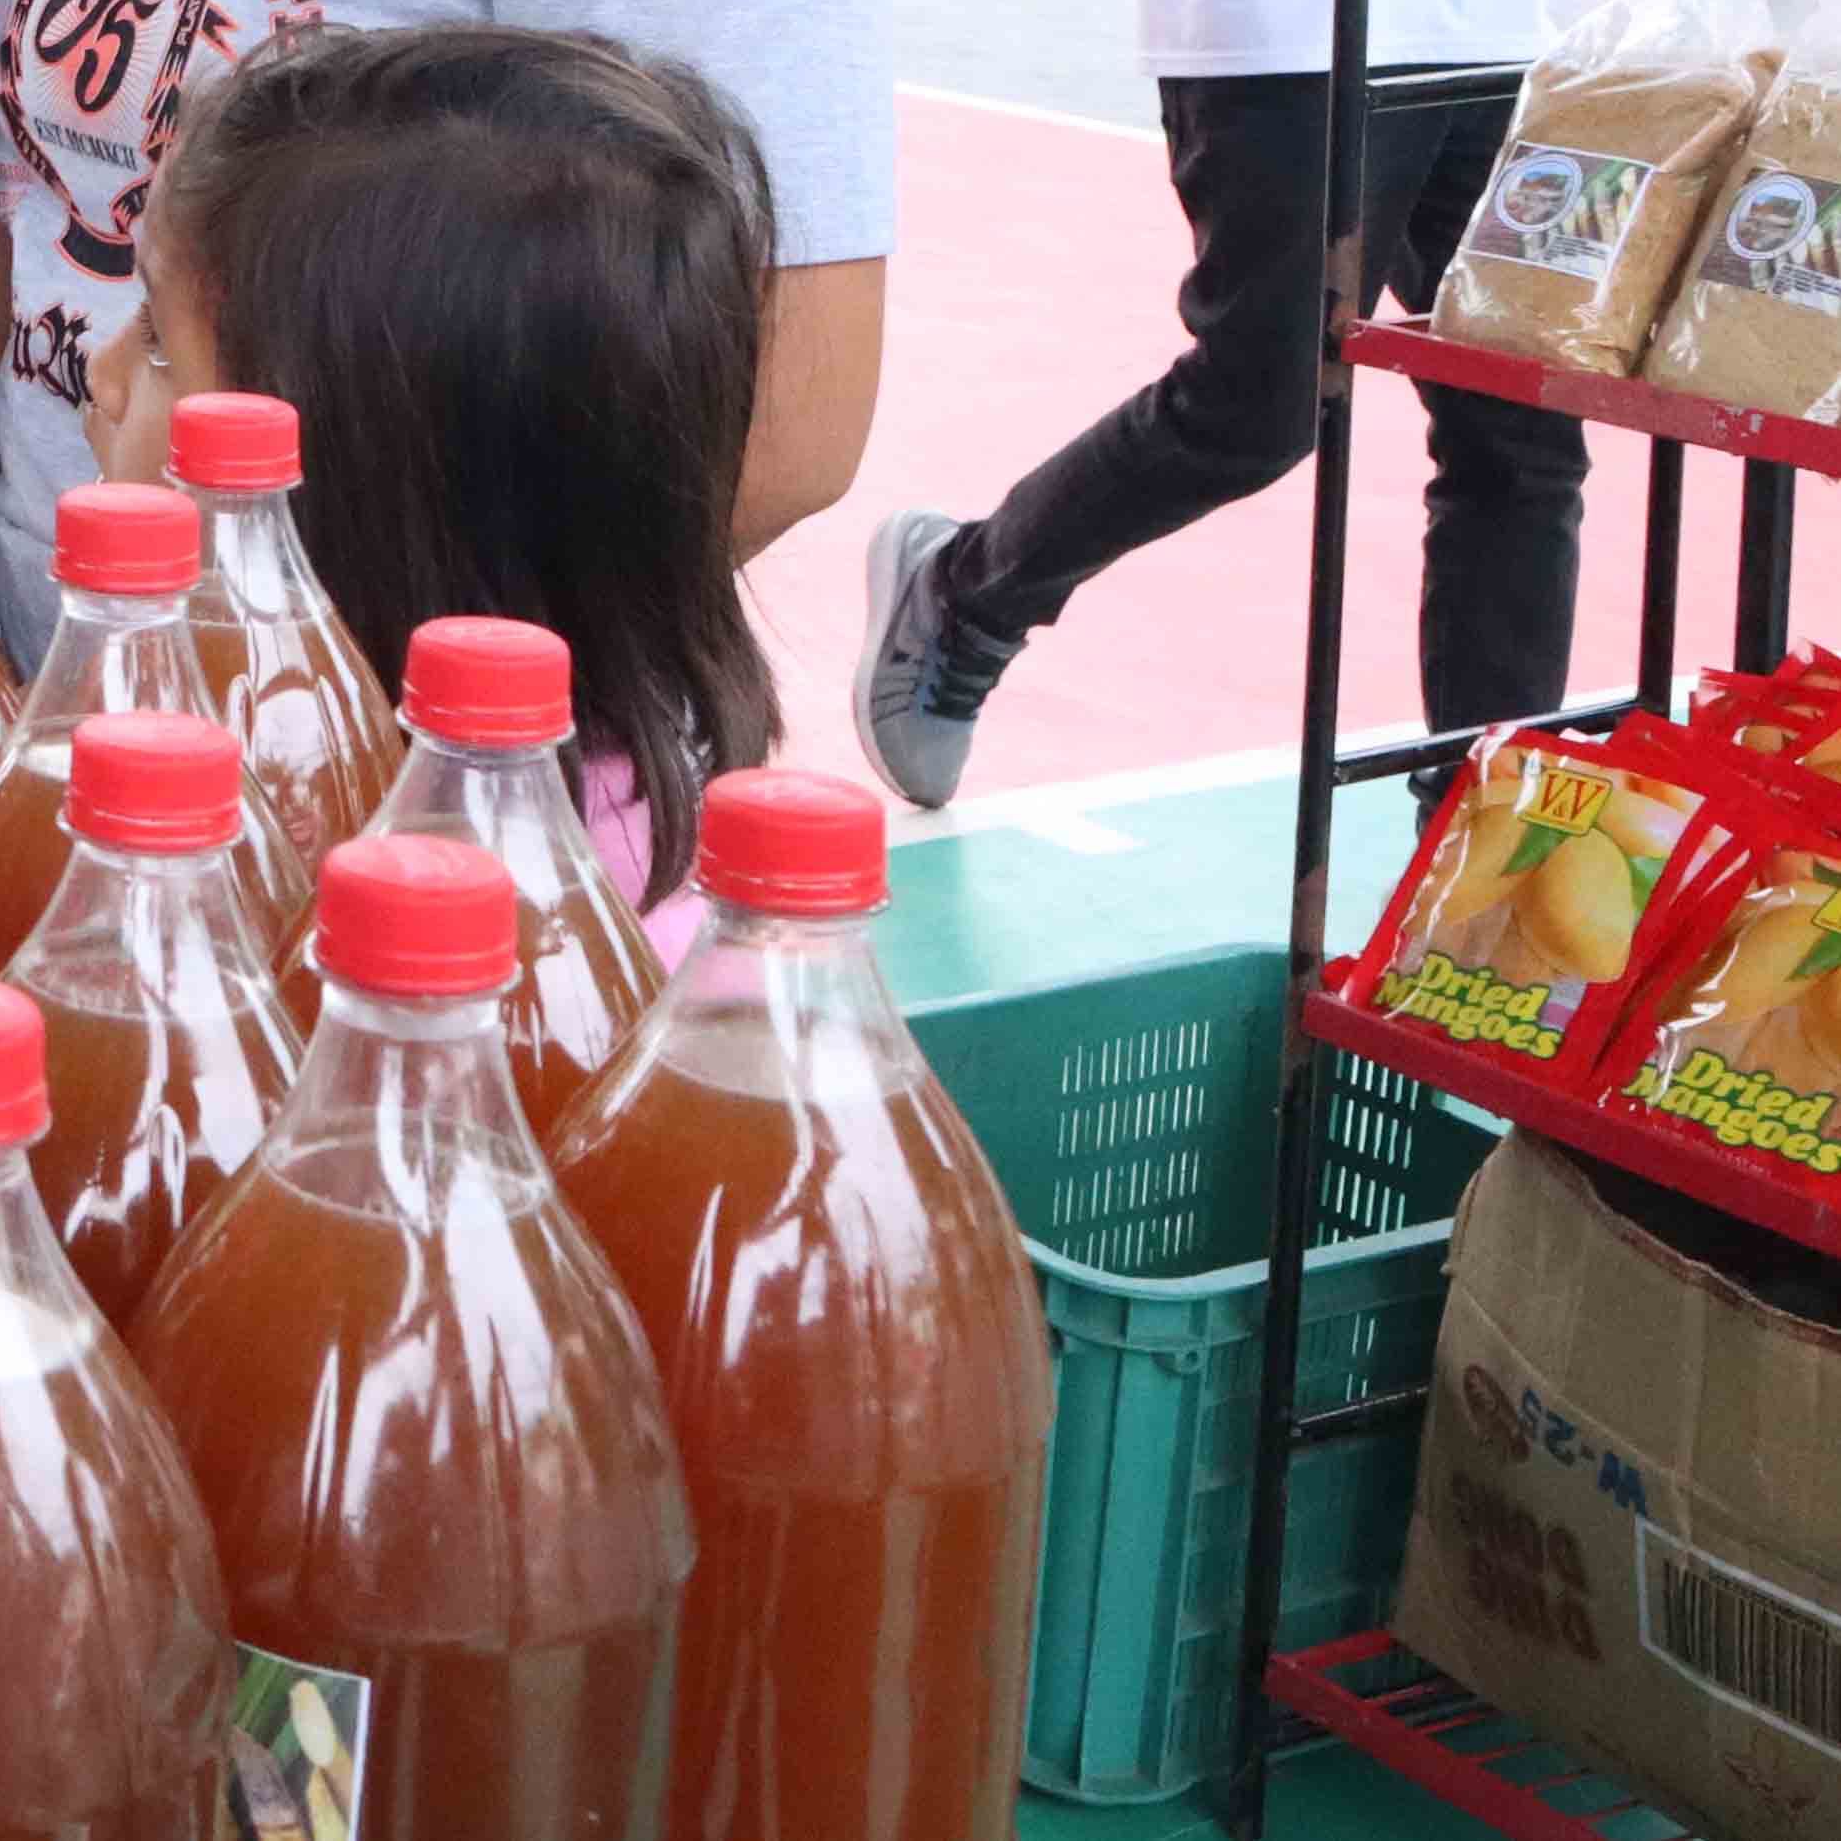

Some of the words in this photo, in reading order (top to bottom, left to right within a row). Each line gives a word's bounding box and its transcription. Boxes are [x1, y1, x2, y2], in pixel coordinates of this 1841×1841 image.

[1539, 772, 1606, 823] V&V
[1373, 969, 1563, 1060] Mangoes
[1420, 950, 1550, 1022] Dried
[1672, 1047, 1836, 1132] Dried
